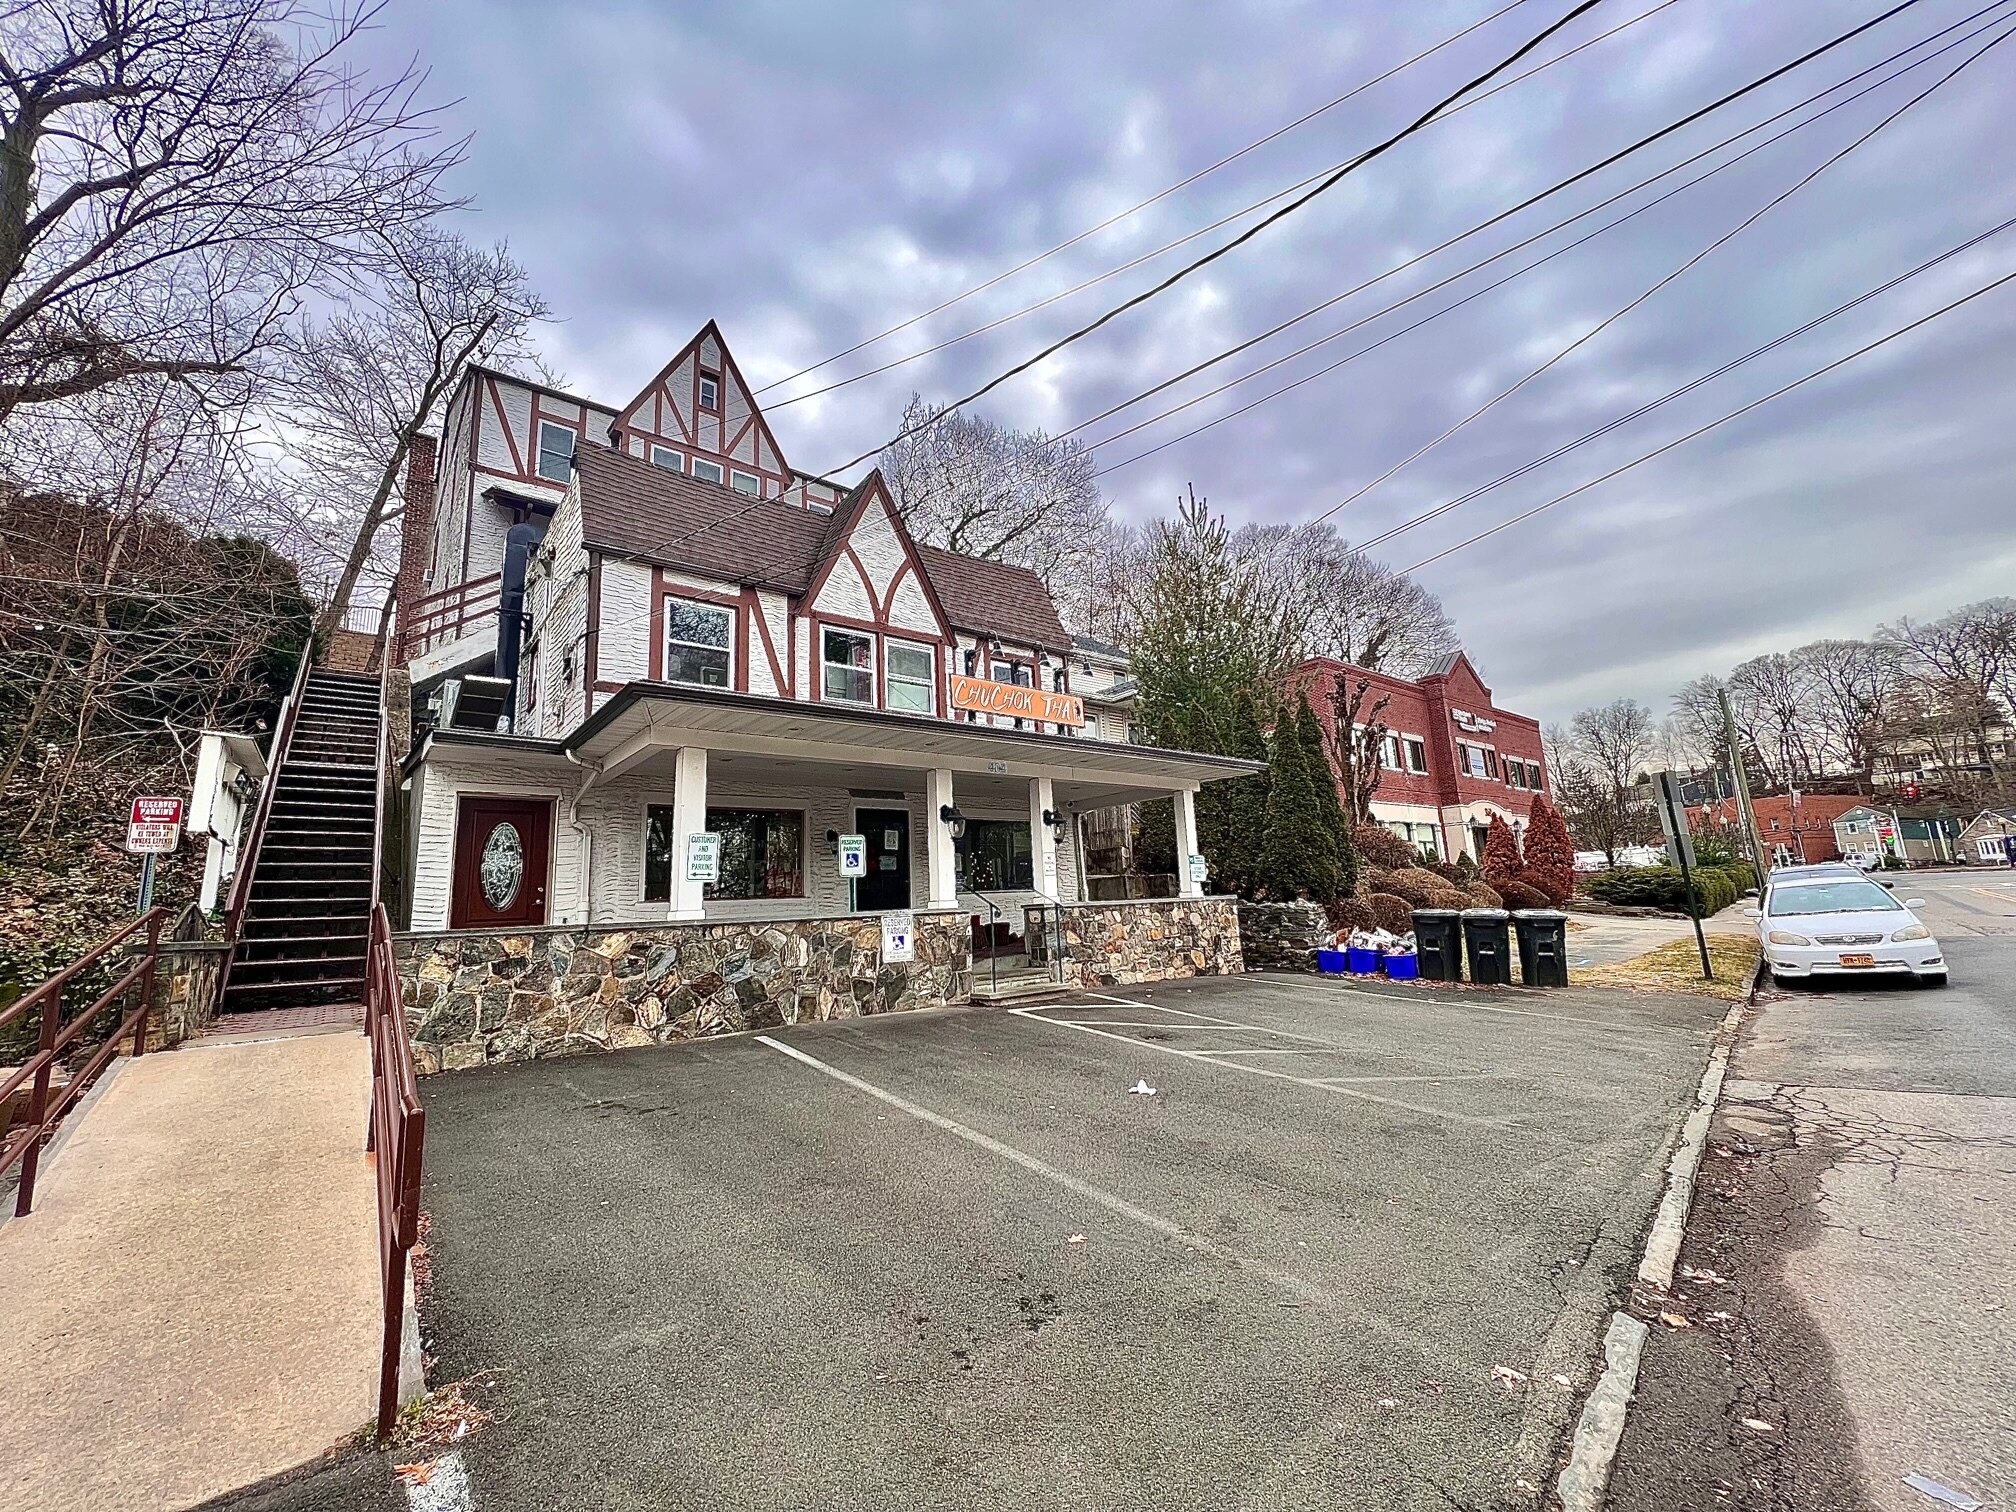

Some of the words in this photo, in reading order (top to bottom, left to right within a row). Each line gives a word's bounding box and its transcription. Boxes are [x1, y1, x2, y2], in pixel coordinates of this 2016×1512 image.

[987, 760, 1007, 774] 404
[138, 800, 178, 808] RESERVED
[140, 808, 174, 816] PARKING
[884, 918, 911, 927] RESERVED
[886, 926, 909, 935] PARKING
